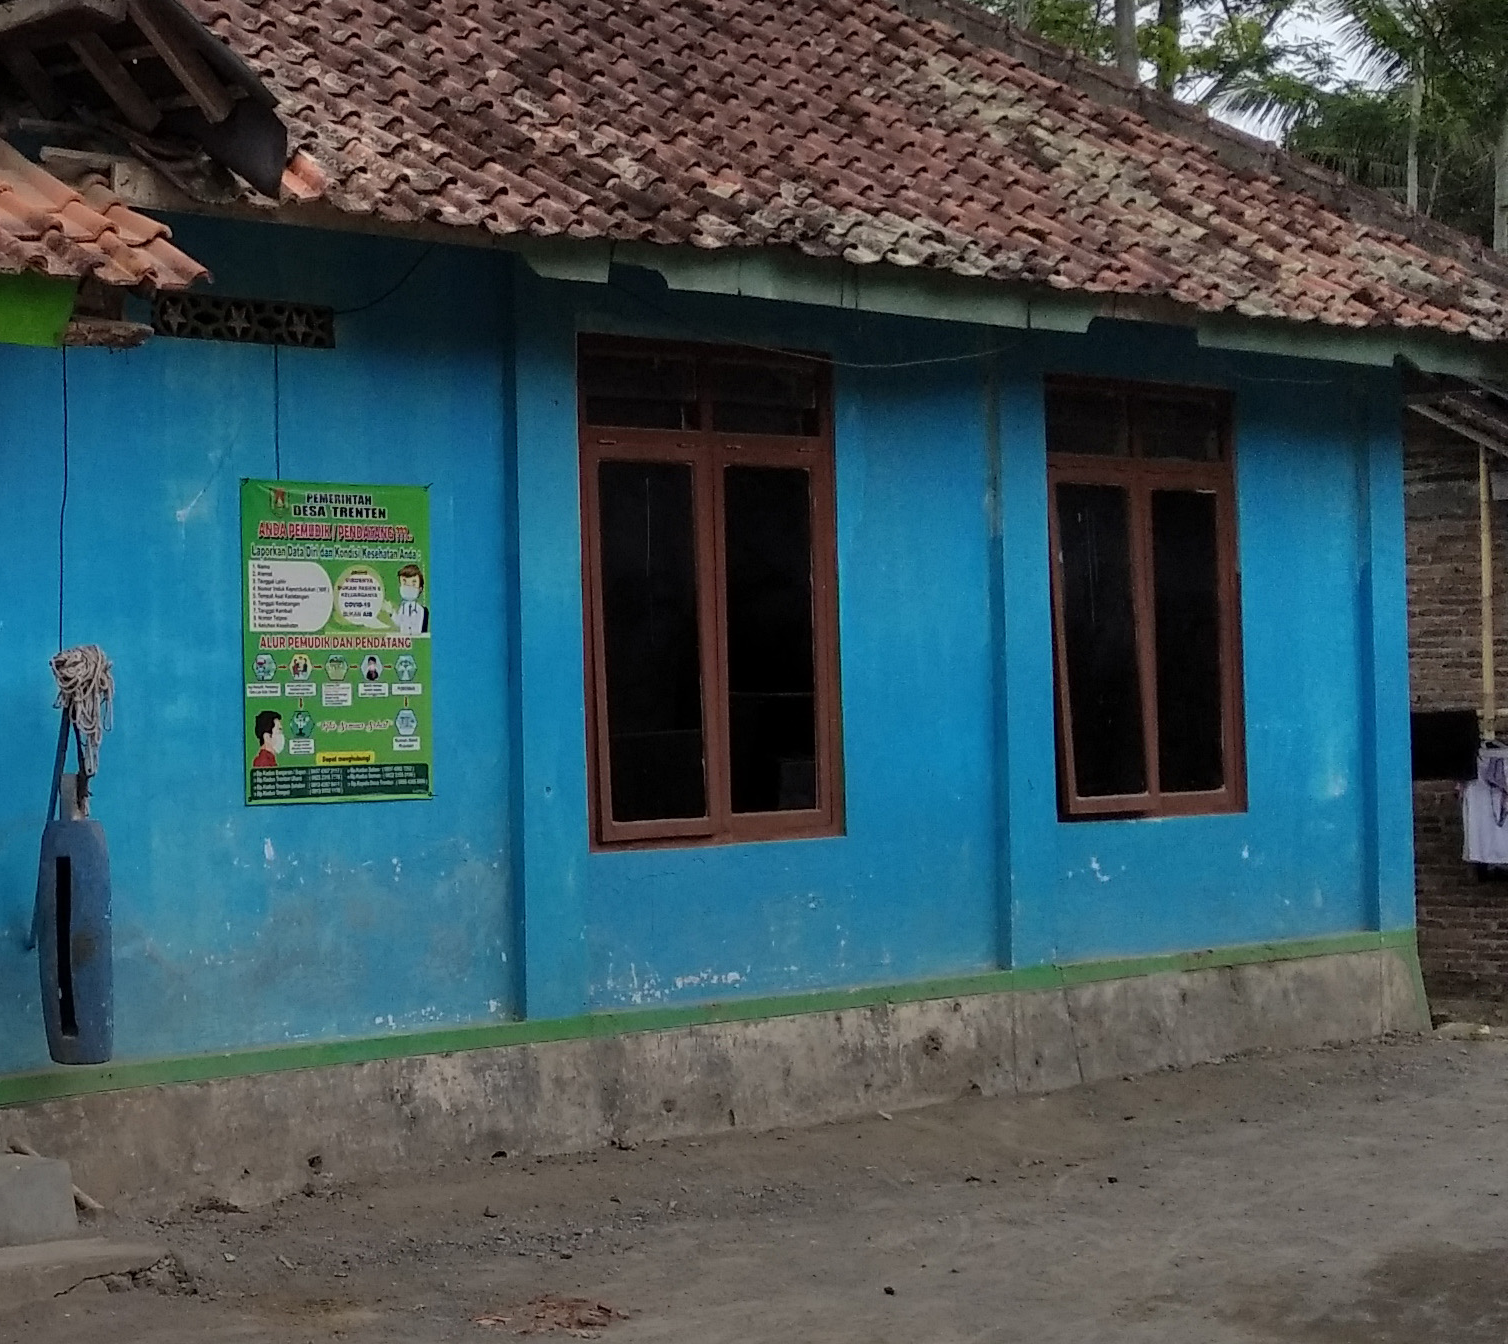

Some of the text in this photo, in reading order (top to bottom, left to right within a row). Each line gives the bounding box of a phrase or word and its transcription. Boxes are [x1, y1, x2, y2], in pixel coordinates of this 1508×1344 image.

[307, 493, 372, 506] PEMERINTAH
[293, 505, 386, 519] DESA TRENTEN
[258, 522, 286, 538] ANDA
[288, 523, 332, 540] PEMUDIK
[338, 525, 395, 542] PENDATANG
[251, 544, 286, 558] Laporkan
[288, 545, 304, 557] Data
[320, 546, 333, 557] dan
[334, 546, 361, 558] Kondisi
[362, 547, 398, 559] Kesehatan
[399, 548, 416, 560] Anda
[260, 636, 411, 648] ALUR PEMUDIK DAN PENDATANG
